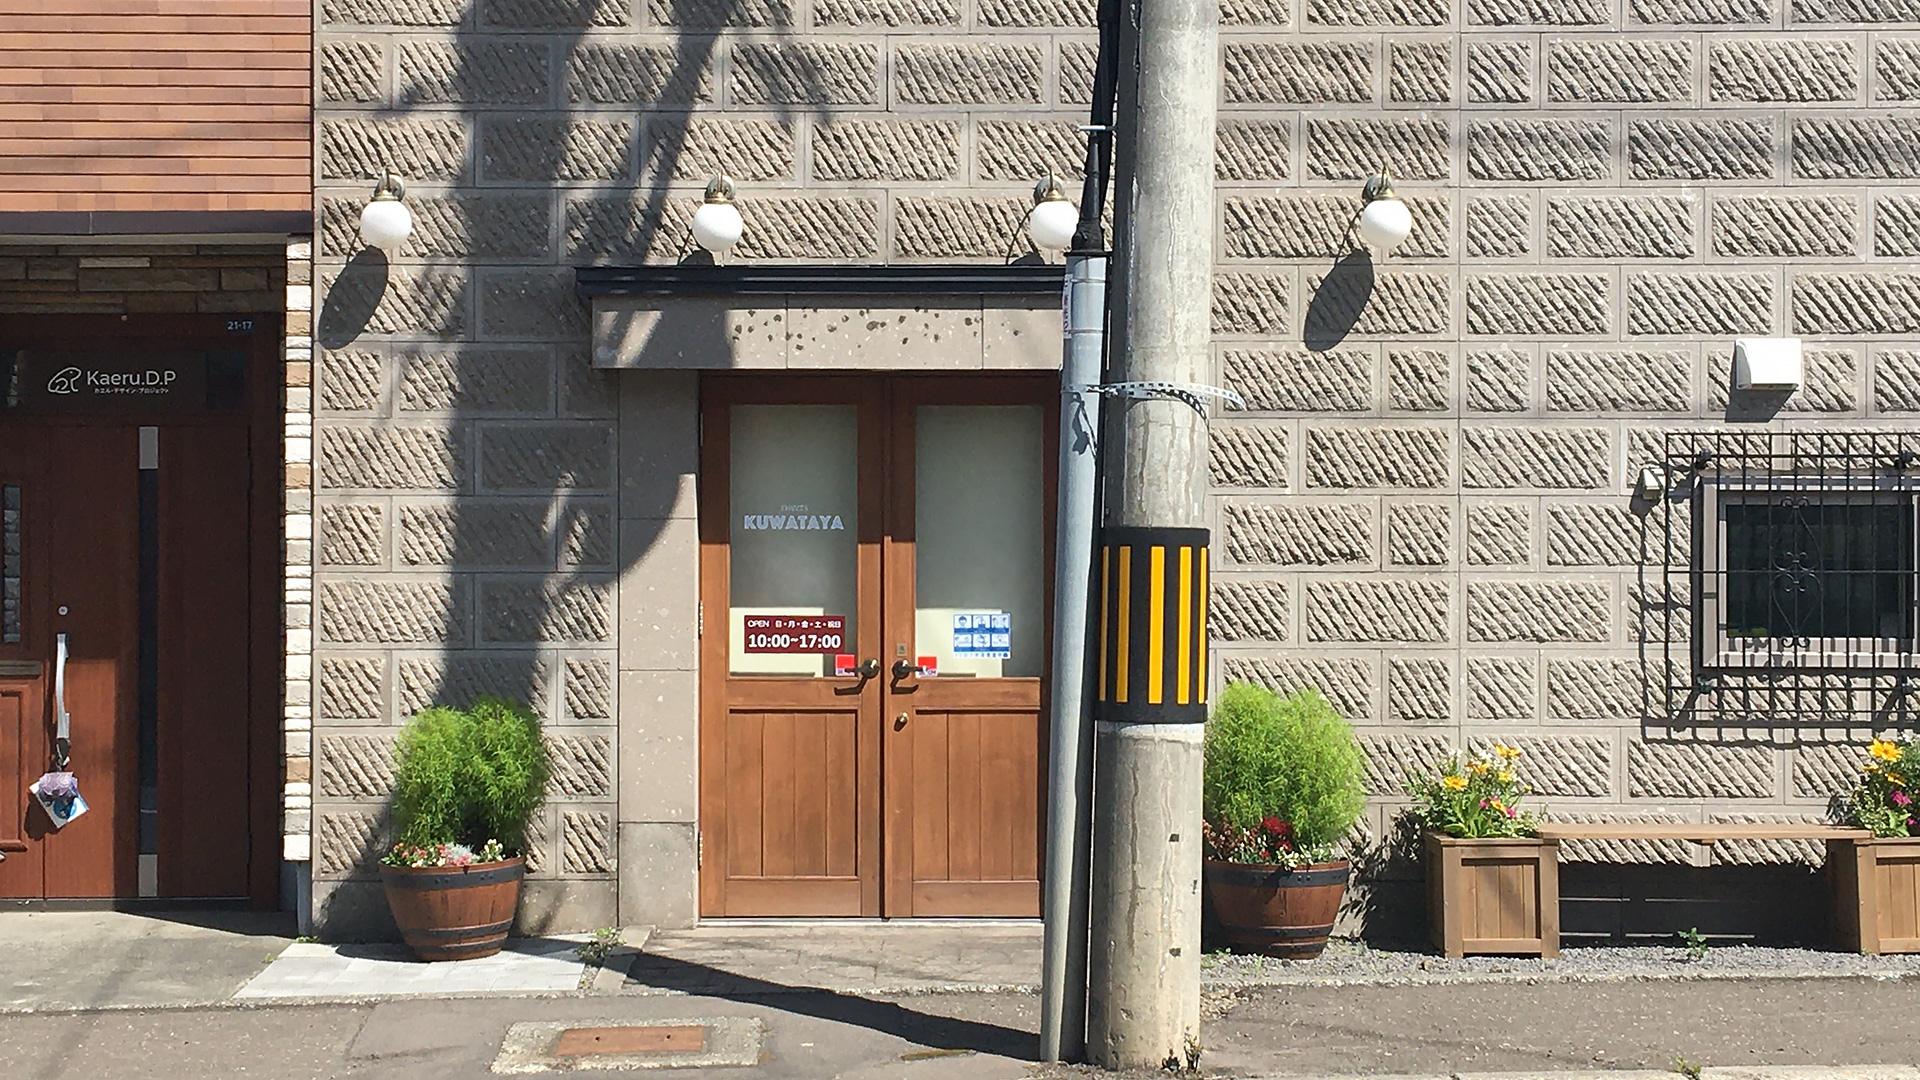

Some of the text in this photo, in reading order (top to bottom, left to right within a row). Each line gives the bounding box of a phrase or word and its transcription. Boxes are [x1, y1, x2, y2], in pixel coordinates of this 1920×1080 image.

[87, 370, 177, 386] Kaeru.D.P
[743, 514, 844, 530] KUWATAYA
[747, 619, 770, 628] OPEN
